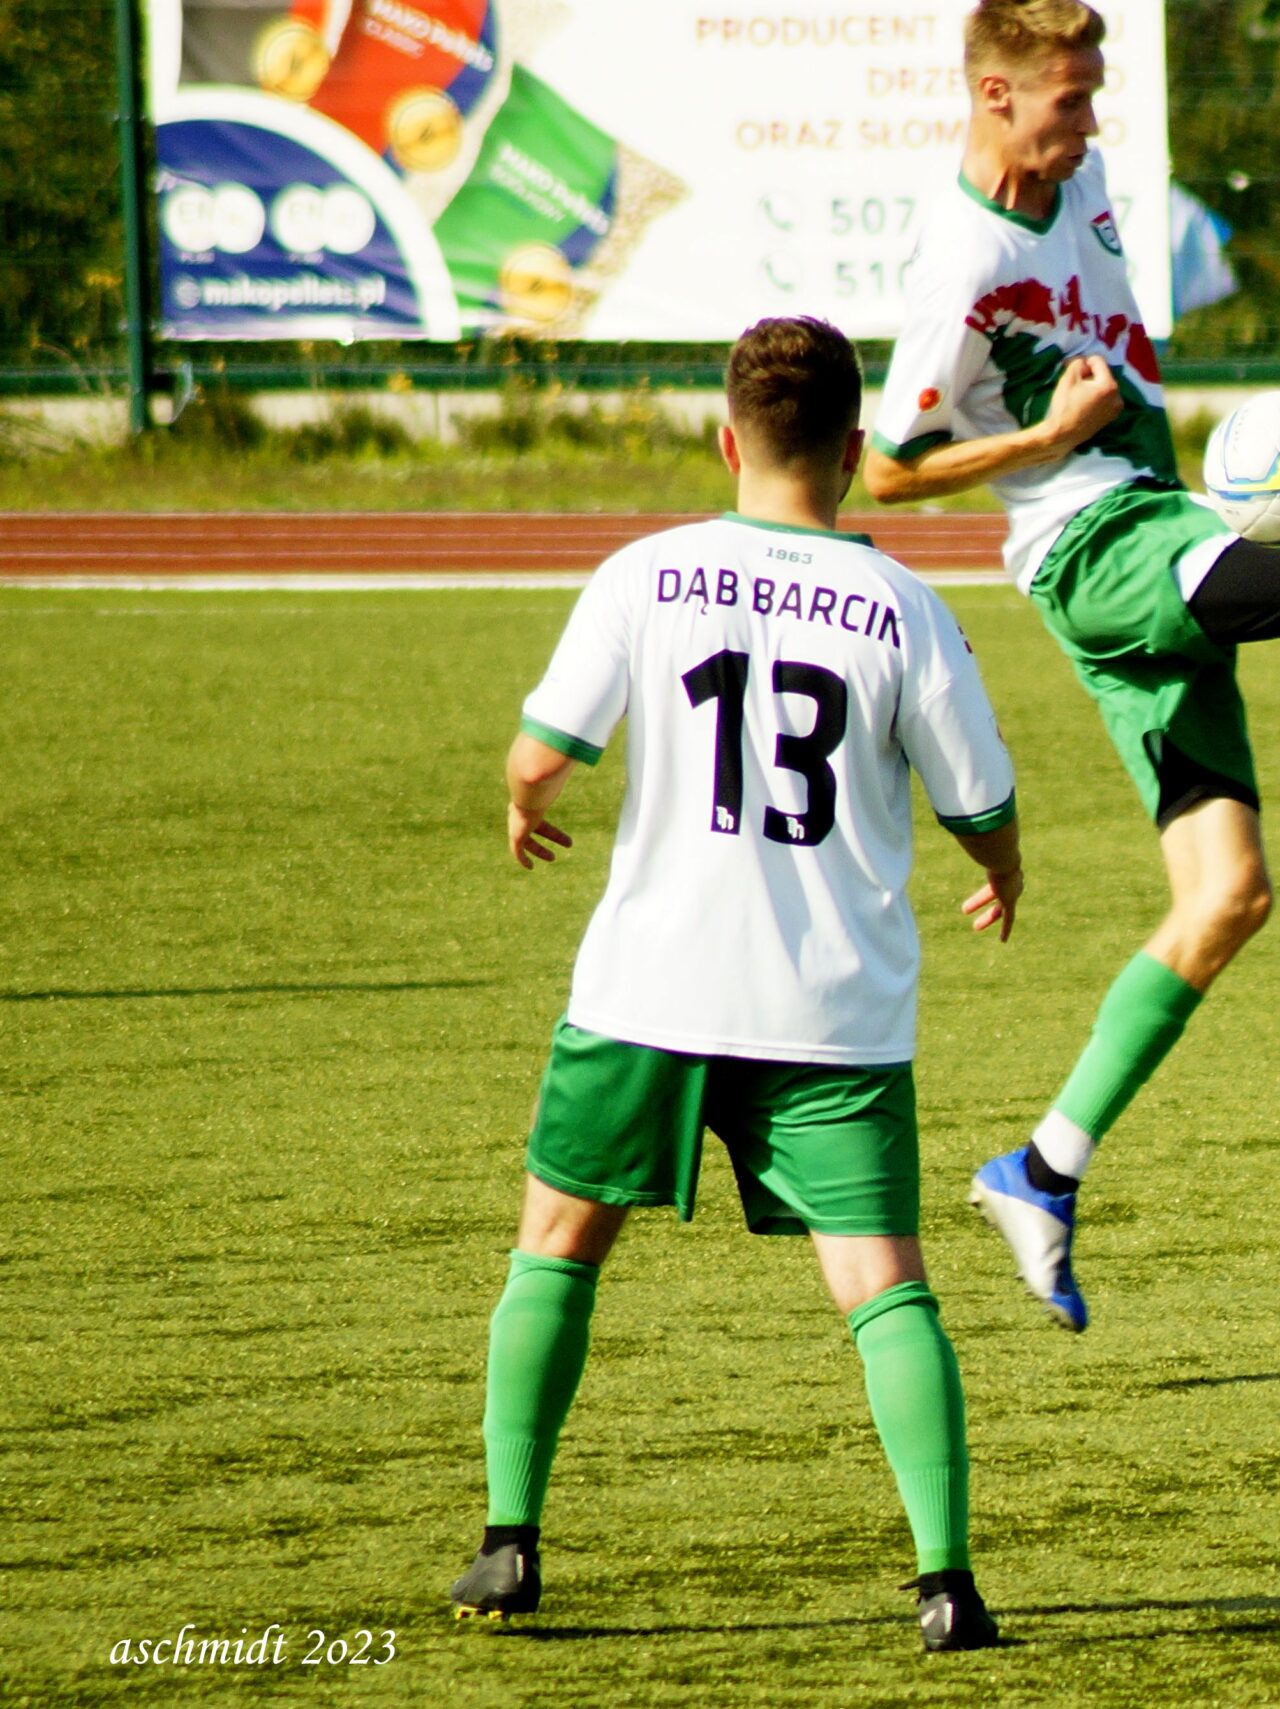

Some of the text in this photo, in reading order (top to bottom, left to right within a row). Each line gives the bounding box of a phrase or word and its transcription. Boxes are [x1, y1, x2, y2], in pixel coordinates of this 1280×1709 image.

[695, 15, 938, 47] PRODUCENT
[734, 120, 842, 151] ORAZ
[766, 546, 813, 565] 1963
[656, 567, 738, 615] DĄB
[681, 648, 847, 846] 13
